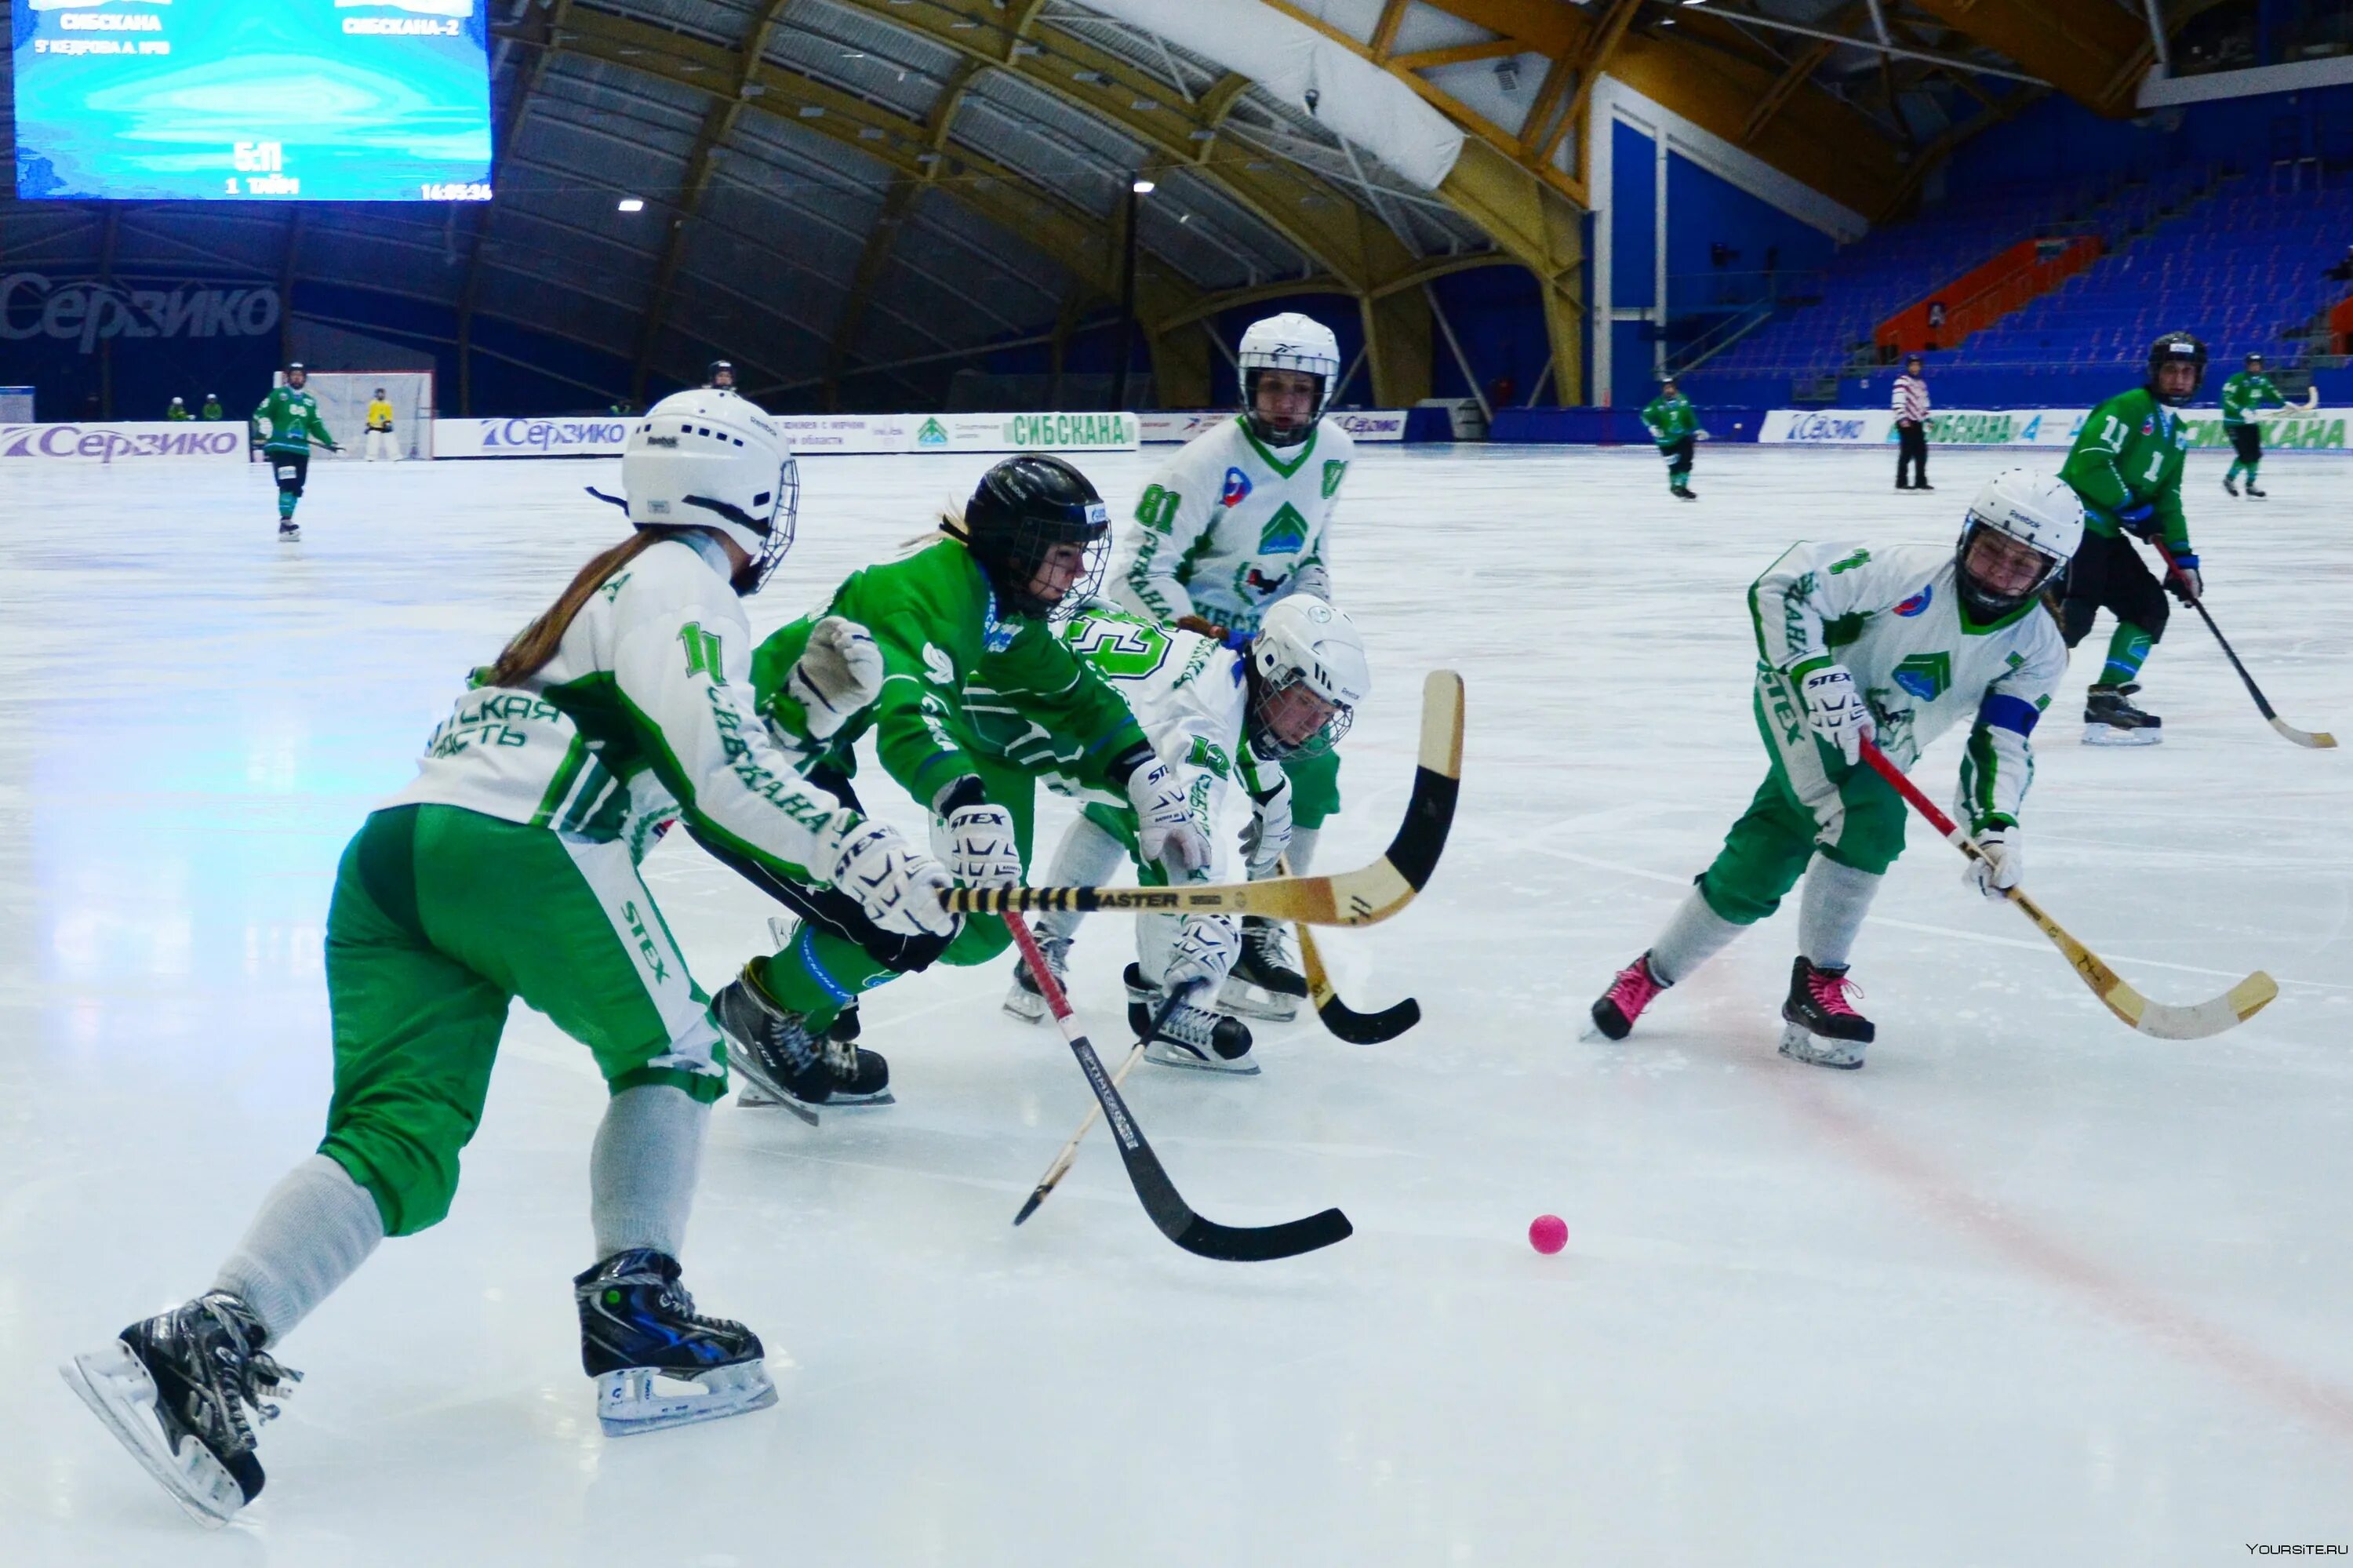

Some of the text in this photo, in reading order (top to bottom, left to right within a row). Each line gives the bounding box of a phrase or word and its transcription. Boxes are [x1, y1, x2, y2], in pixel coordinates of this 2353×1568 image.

[60, 13, 162, 31] СИБСКАНА
[342, 17, 459, 36] СИБСКАНА-2
[247, 173, 300, 194] ТАЙМ
[39, 425, 239, 464] Серзико
[504, 418, 625, 451] Серзико
[1013, 415, 1125, 446] СИБСКАНА
[1135, 483, 1181, 536] 81
[677, 621, 729, 686] 11
[1807, 672, 1853, 690] STEX
[620, 900, 671, 985] STEX
